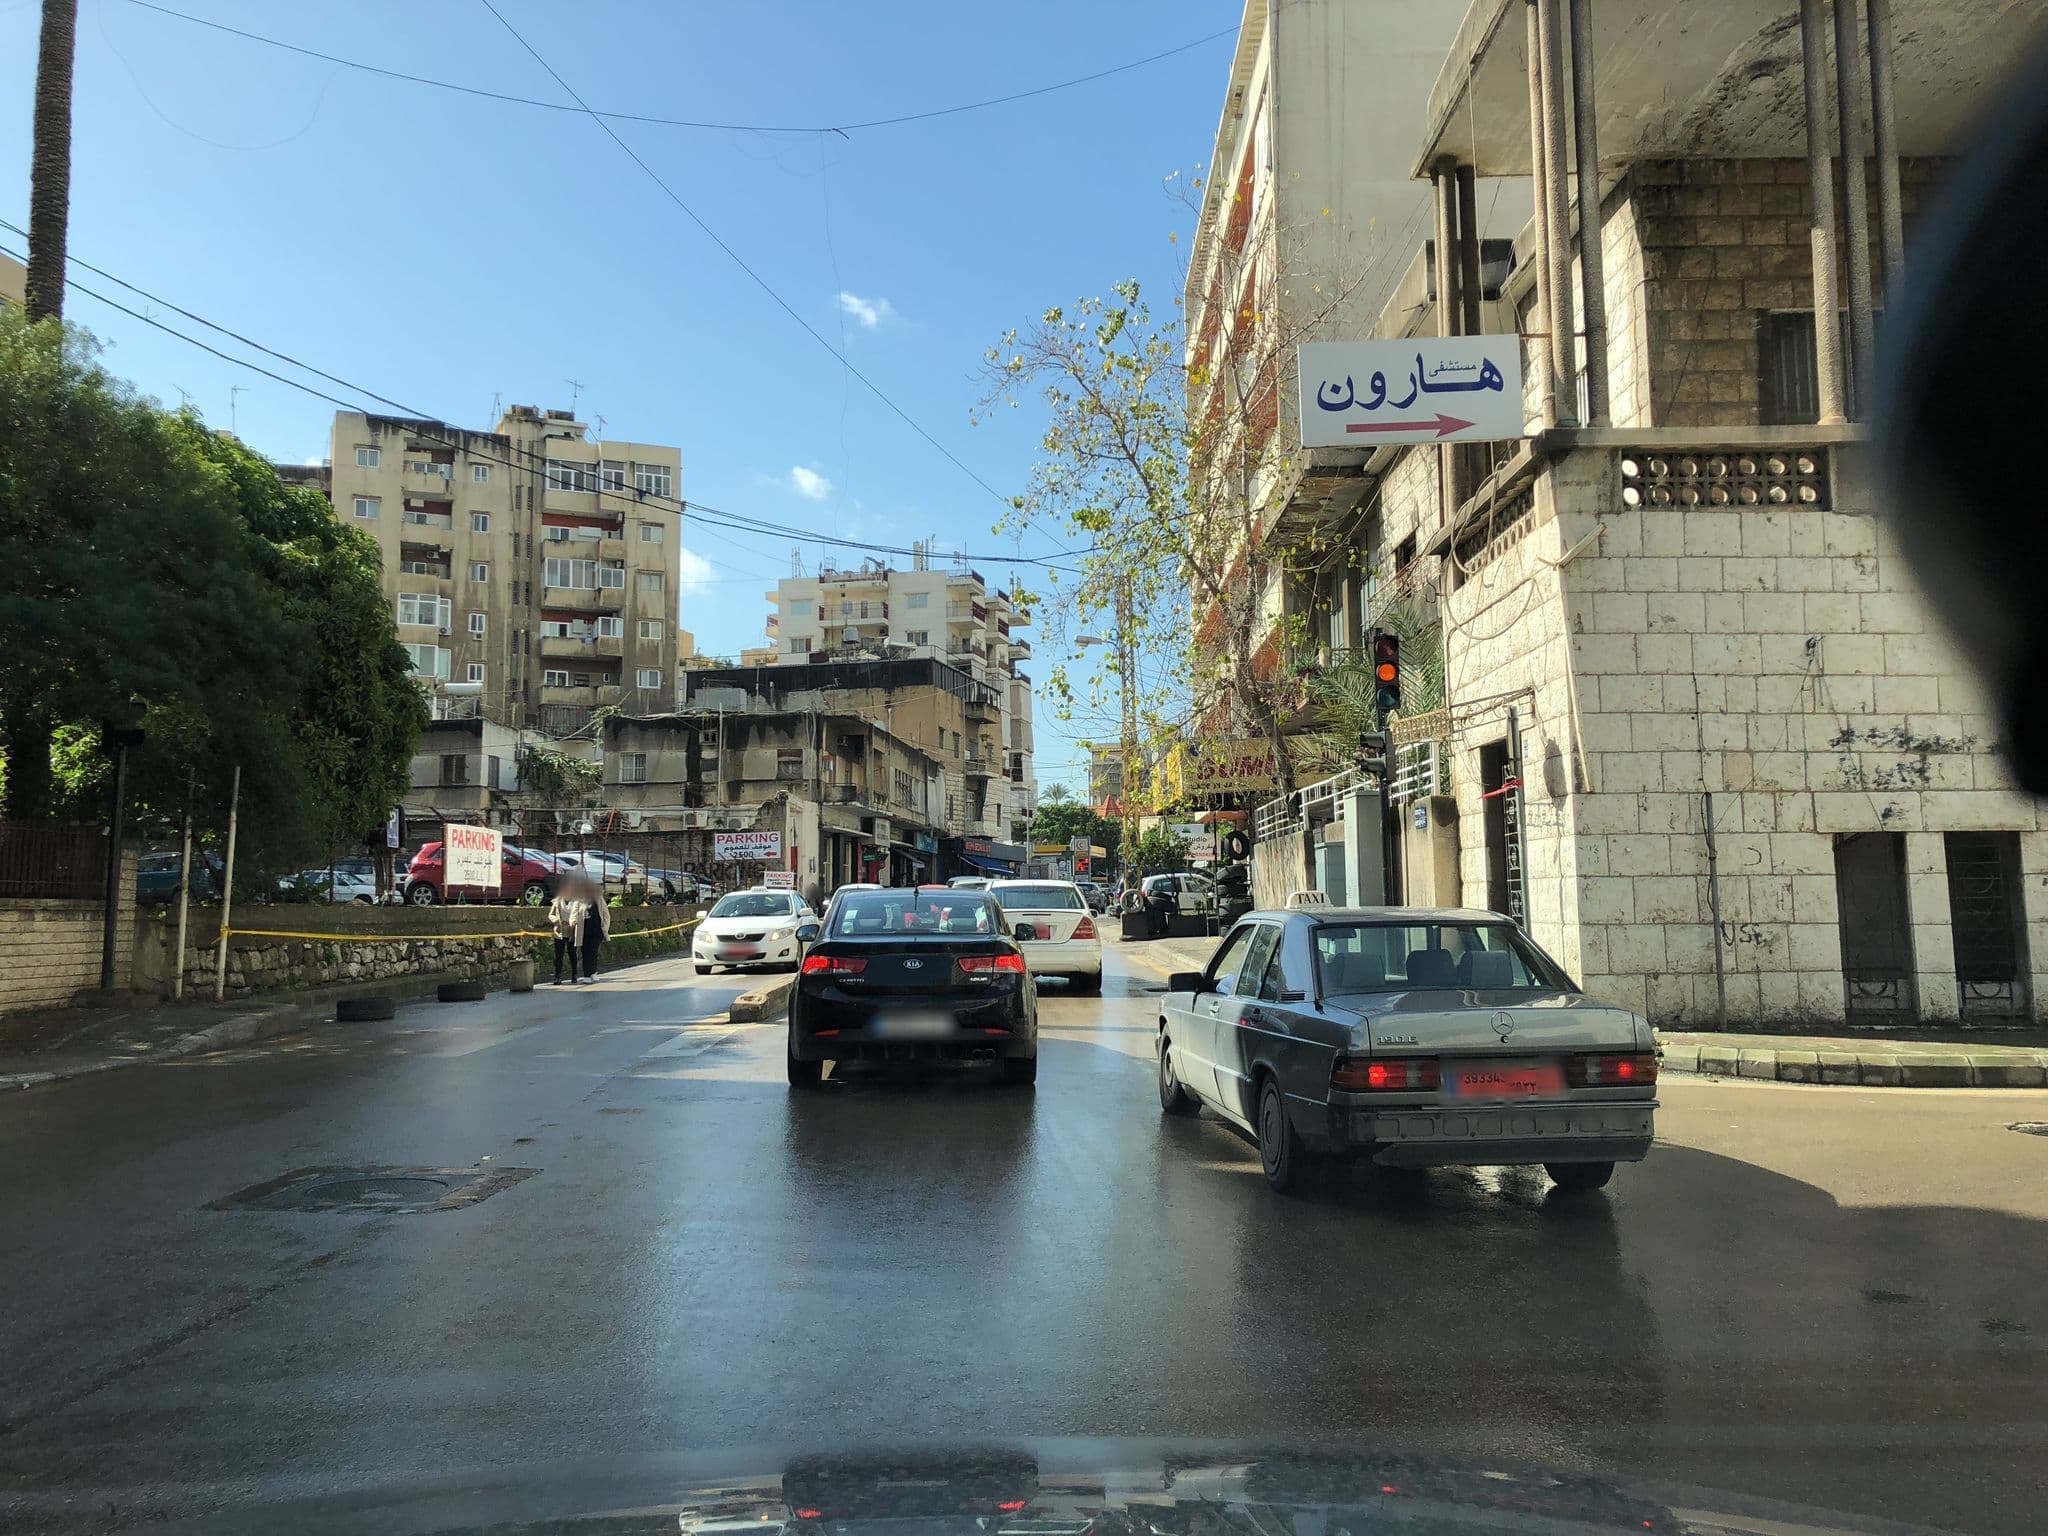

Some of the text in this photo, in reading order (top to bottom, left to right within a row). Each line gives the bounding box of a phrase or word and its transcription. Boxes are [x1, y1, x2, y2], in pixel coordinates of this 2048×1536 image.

[1429, 361, 1476, 377] مستشفى
[1317, 352, 1505, 412] هارون
[452, 829, 495, 852] PARKING
[716, 832, 779, 844] PARKING
[1296, 893, 1324, 904] TAXI
